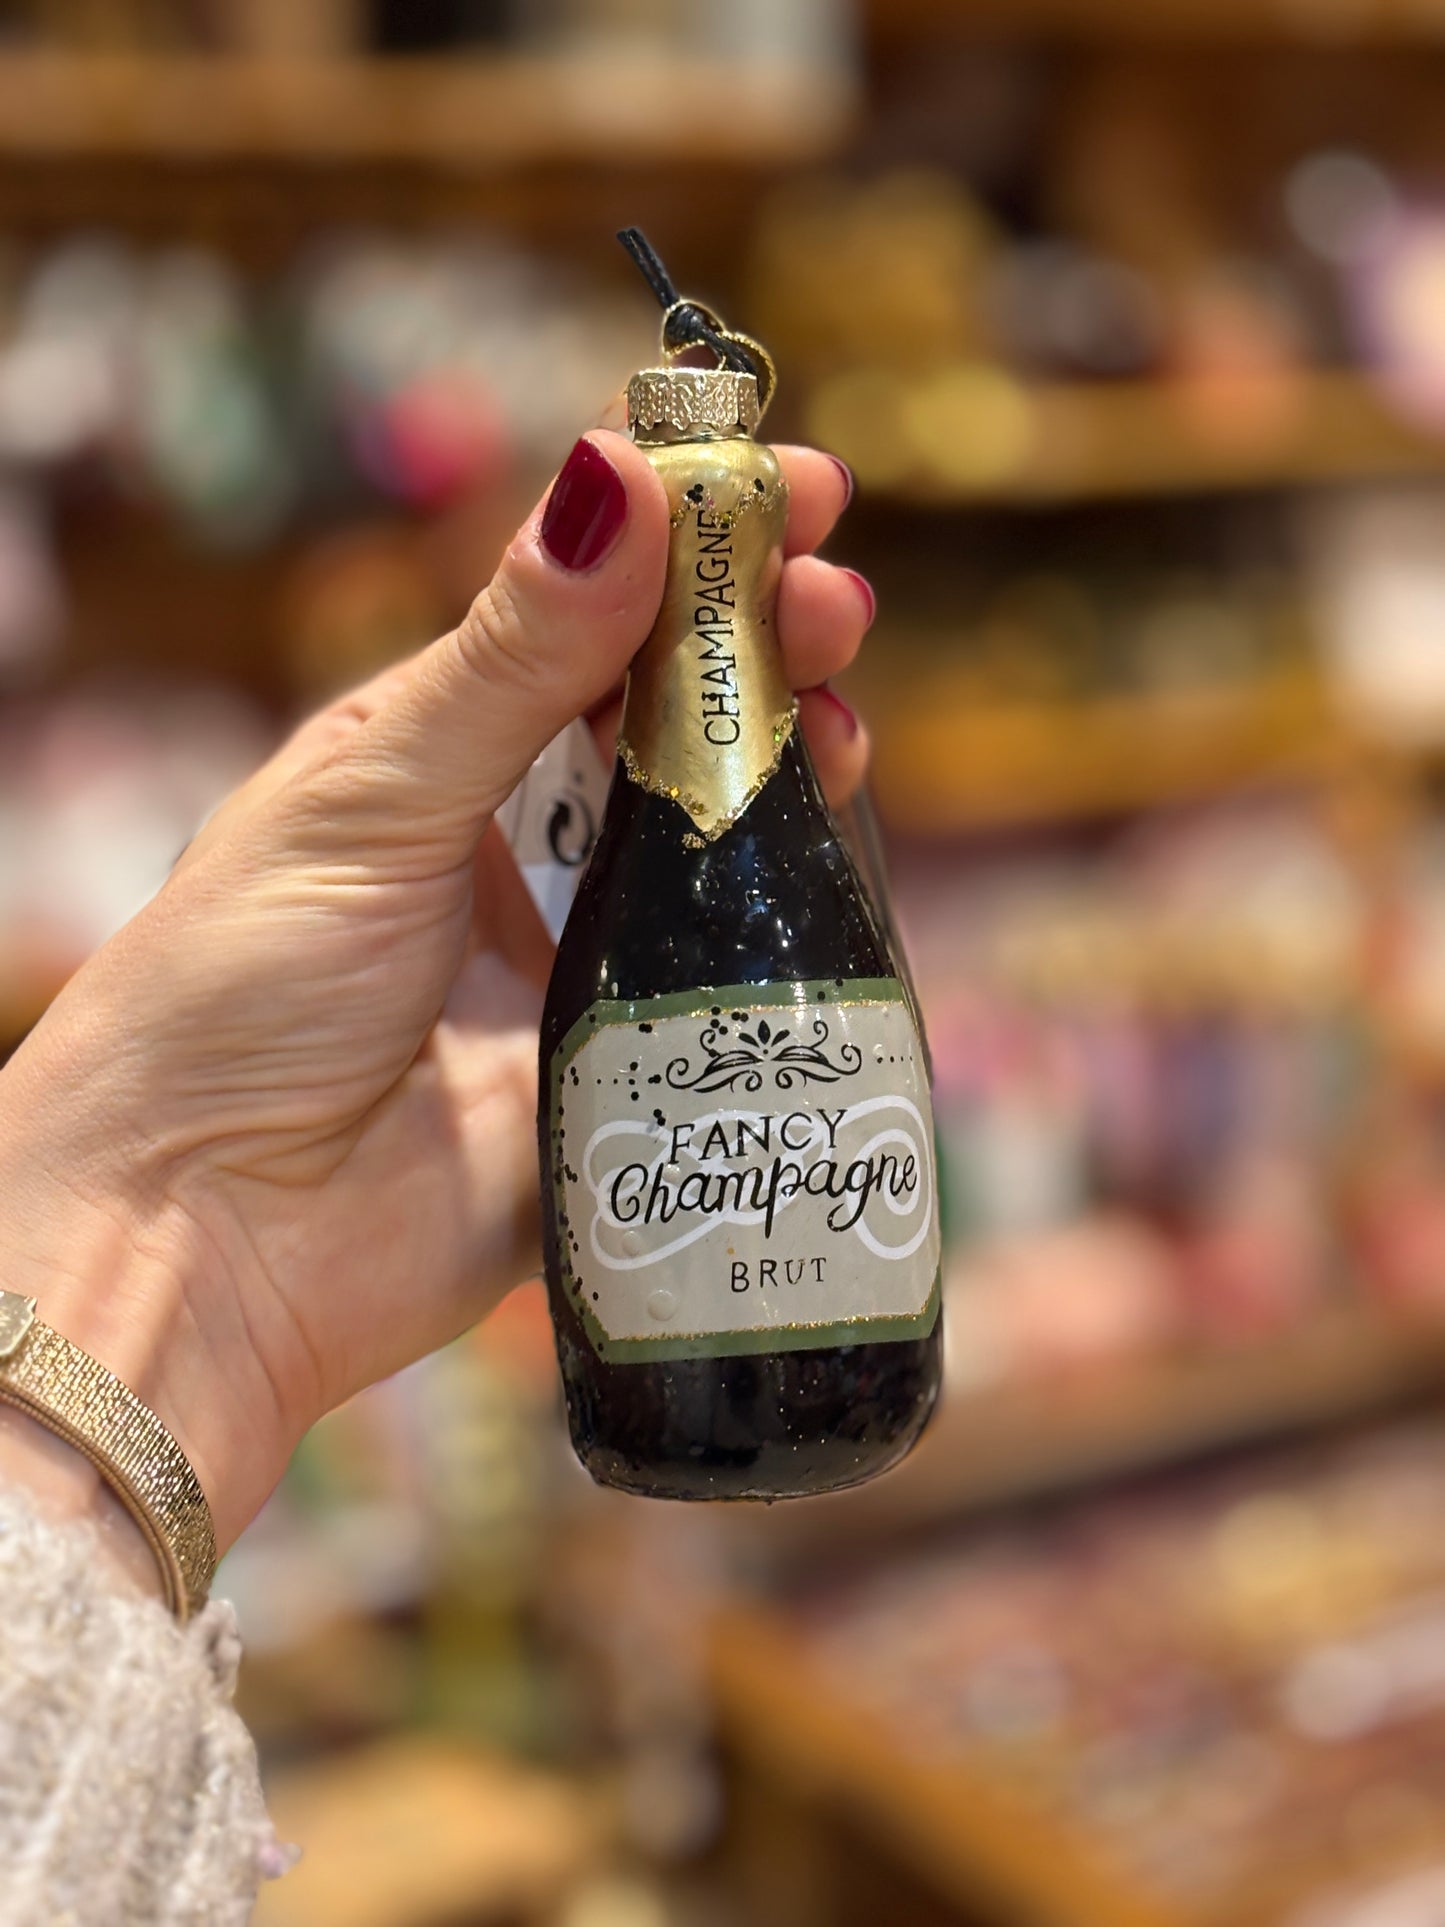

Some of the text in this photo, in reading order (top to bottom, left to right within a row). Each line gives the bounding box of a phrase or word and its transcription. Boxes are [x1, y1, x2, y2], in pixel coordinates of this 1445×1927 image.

[694, 509, 740, 746] CHAMPAGNE
[668, 1109, 848, 1164] FANCY
[610, 1152, 918, 1239] Champagne
[730, 1257, 827, 1293] BRUT
